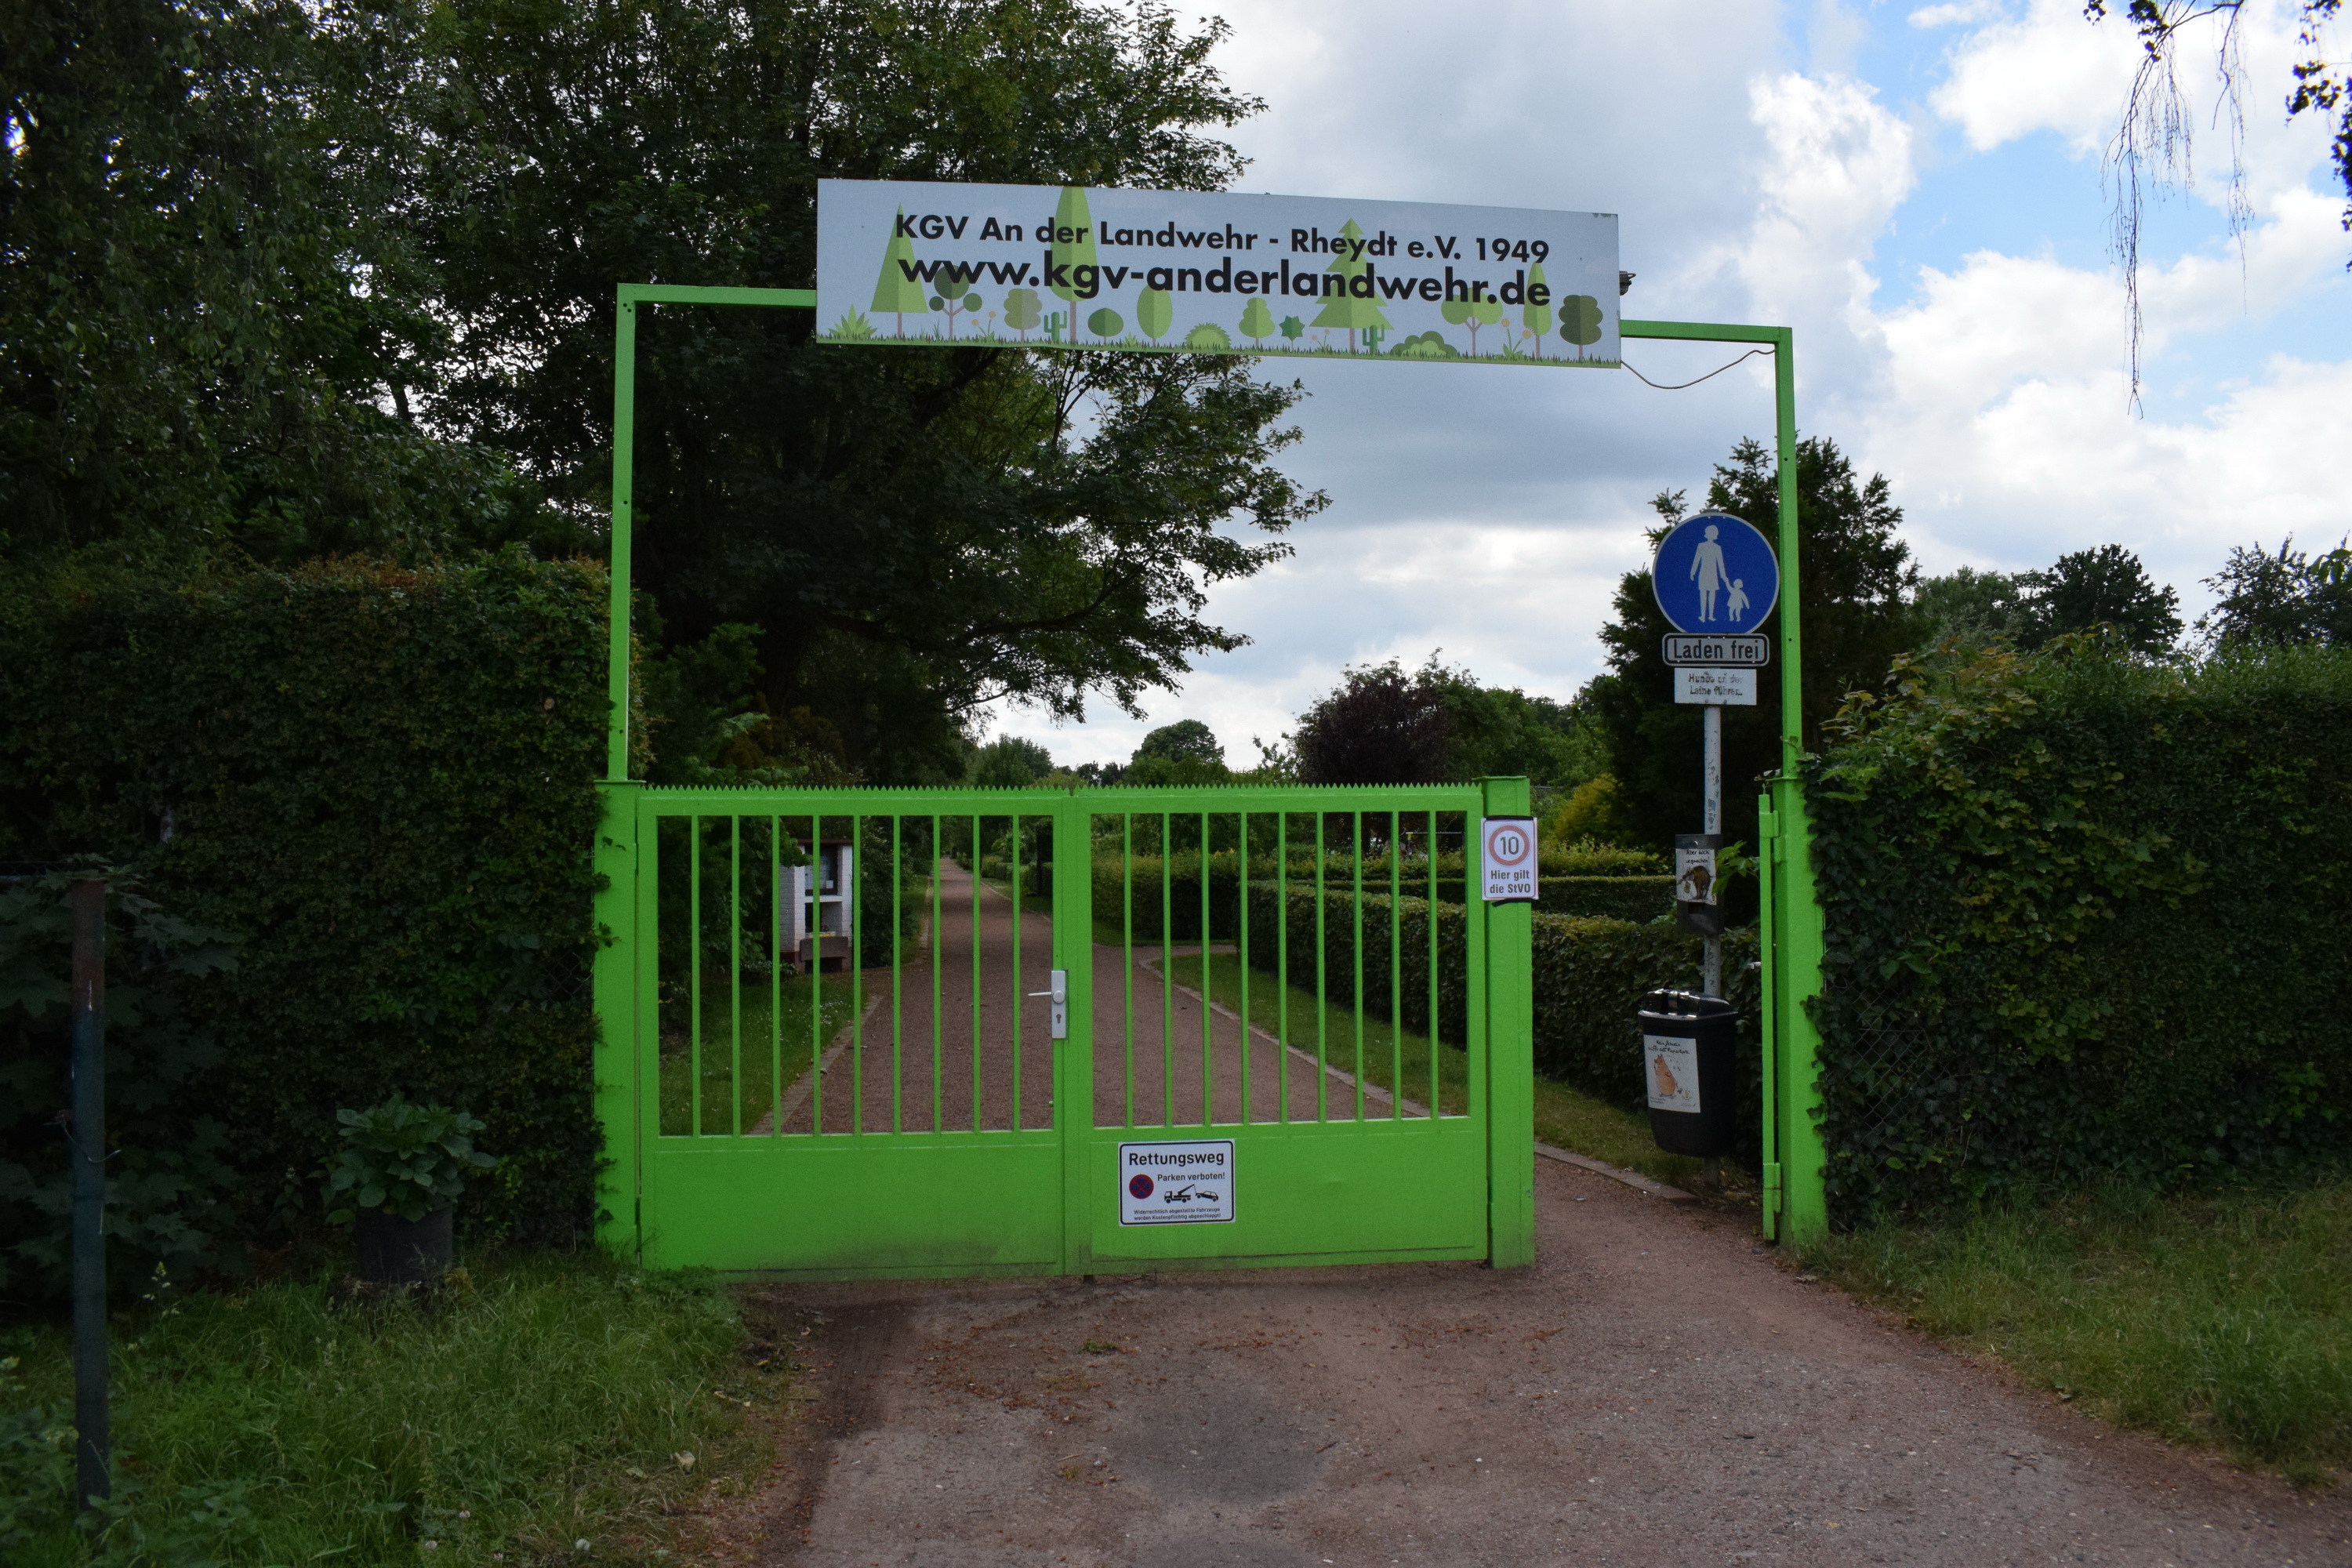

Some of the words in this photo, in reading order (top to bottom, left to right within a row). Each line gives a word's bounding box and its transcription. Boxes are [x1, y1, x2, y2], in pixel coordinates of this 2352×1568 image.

[896, 214, 969, 240] KGV
[979, 216, 1023, 241] An
[1035, 216, 1089, 244] der
[1100, 221, 1258, 251] Landwehr
[1290, 227, 1398, 262] Rheydt
[1407, 235, 1461, 260] e.V.
[1475, 238, 1550, 263] 1949
[898, 250, 1551, 307] www.kgv-anderlandwehr.de
[1673, 639, 1723, 659] Laden
[1731, 640, 1759, 659] frei
[1690, 686, 1711, 695] Leine
[1500, 836, 1519, 855] 10
[1490, 869, 1510, 880] Hier
[1513, 869, 1530, 881] gilt
[1490, 884, 1504, 894] die
[1507, 884, 1530, 893] StVO
[1129, 1152, 1224, 1167] Rettungsweg
[1188, 1172, 1225, 1181] verboten!
